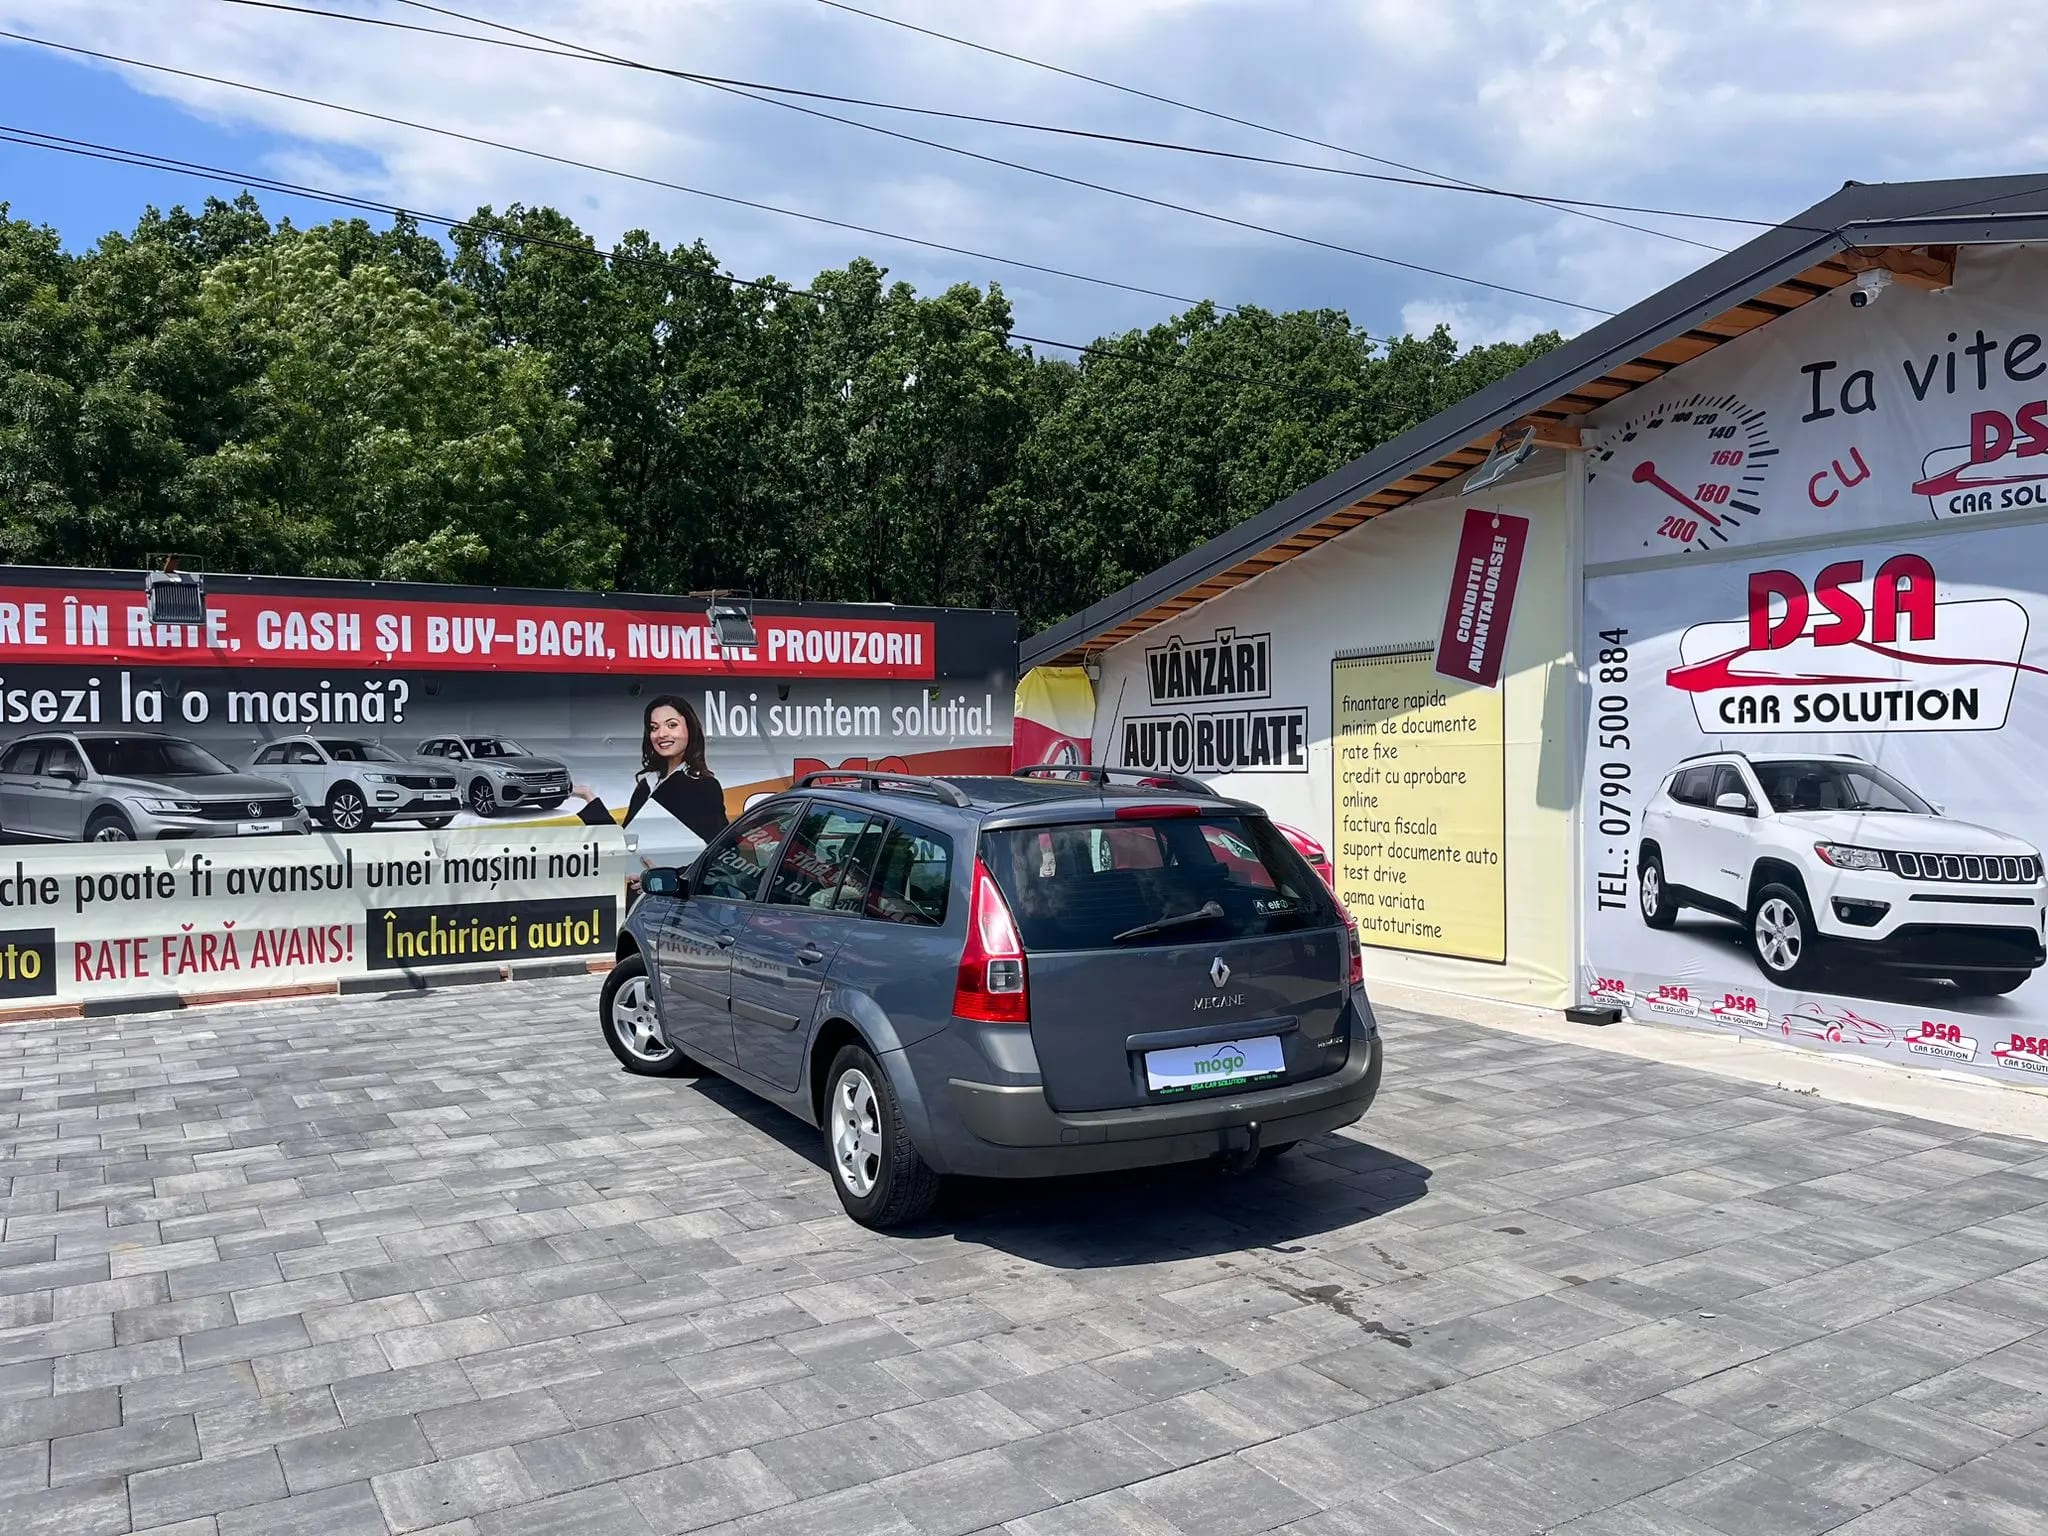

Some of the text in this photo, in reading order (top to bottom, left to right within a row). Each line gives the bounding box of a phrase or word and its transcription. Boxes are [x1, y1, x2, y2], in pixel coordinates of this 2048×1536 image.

[1801, 361, 1876, 423] Ia
[1671, 411, 1693, 423] 100
[1693, 413, 1718, 425] 120
[1708, 426, 1737, 439] 140
[1710, 450, 1743, 466] 160
[1808, 446, 1871, 507] cu
[1694, 483, 1731, 504] 180
[1949, 485, 2048, 514] CAR SOL
[1656, 515, 1698, 543] 200
[1456, 557, 1485, 643] CONDITII
[1468, 535, 1507, 674] AVANTAJOASE!
[1748, 553, 1936, 651] DSA
[0, 602, 48, 645] RE
[63, 595, 109, 646] ÎN
[257, 610, 361, 651] CASH
[375, 614, 412, 662] ȘI
[427, 616, 616, 660] BUY-BACK,
[628, 623, 758, 661] NUME
[768, 628, 922, 665] PROVIZORII
[1150, 635, 1267, 699] VÂNZĂRI
[121, 671, 163, 723] la
[182, 689, 209, 723] o
[228, 678, 410, 733] mașină?
[1342, 689, 1447, 712] finantare rapida
[1719, 687, 1979, 725] CAR SOLUTION
[704, 689, 992, 745] Noi suntem soluția!
[1342, 715, 1477, 736] minim de documente
[1123, 714, 1304, 768] AUTO RULATE
[1342, 742, 1398, 760] rate fixe
[1342, 767, 1467, 789] credit cu aprobare
[1598, 627, 1631, 912] TEL.: 0790 500 884
[1342, 790, 1379, 808] online
[1343, 814, 1437, 836] factura fiscala
[1343, 841, 1498, 865] suport documente auto
[0, 842, 599, 913] che poate fi avansul unei mașini noi!
[1343, 864, 1407, 884] test drive
[1343, 891, 1425, 911] gama variata
[383, 908, 600, 959] Închirieri auto!
[1362, 916, 1442, 938] autoturisme
[0, 944, 41, 980] to
[75, 920, 353, 982] RATE FĂRĂ AVANS!
[1598, 977, 1625, 993] DSA
[1659, 986, 1688, 1001] DSA
[1192, 994, 1245, 1011] MEGANE
[1666, 1006, 1695, 1016] SOLUTION
[1725, 993, 1757, 1012] DSA
[1922, 1020, 1960, 1043] DSA
[1914, 1044, 1969, 1060] CAR SOLUTION
[2010, 1033, 2048, 1057] DSA
[1194, 1055, 1245, 1077] mogo
[2003, 1058, 2020, 1068] CAR
[1205, 1081, 1218, 1089] CAR
